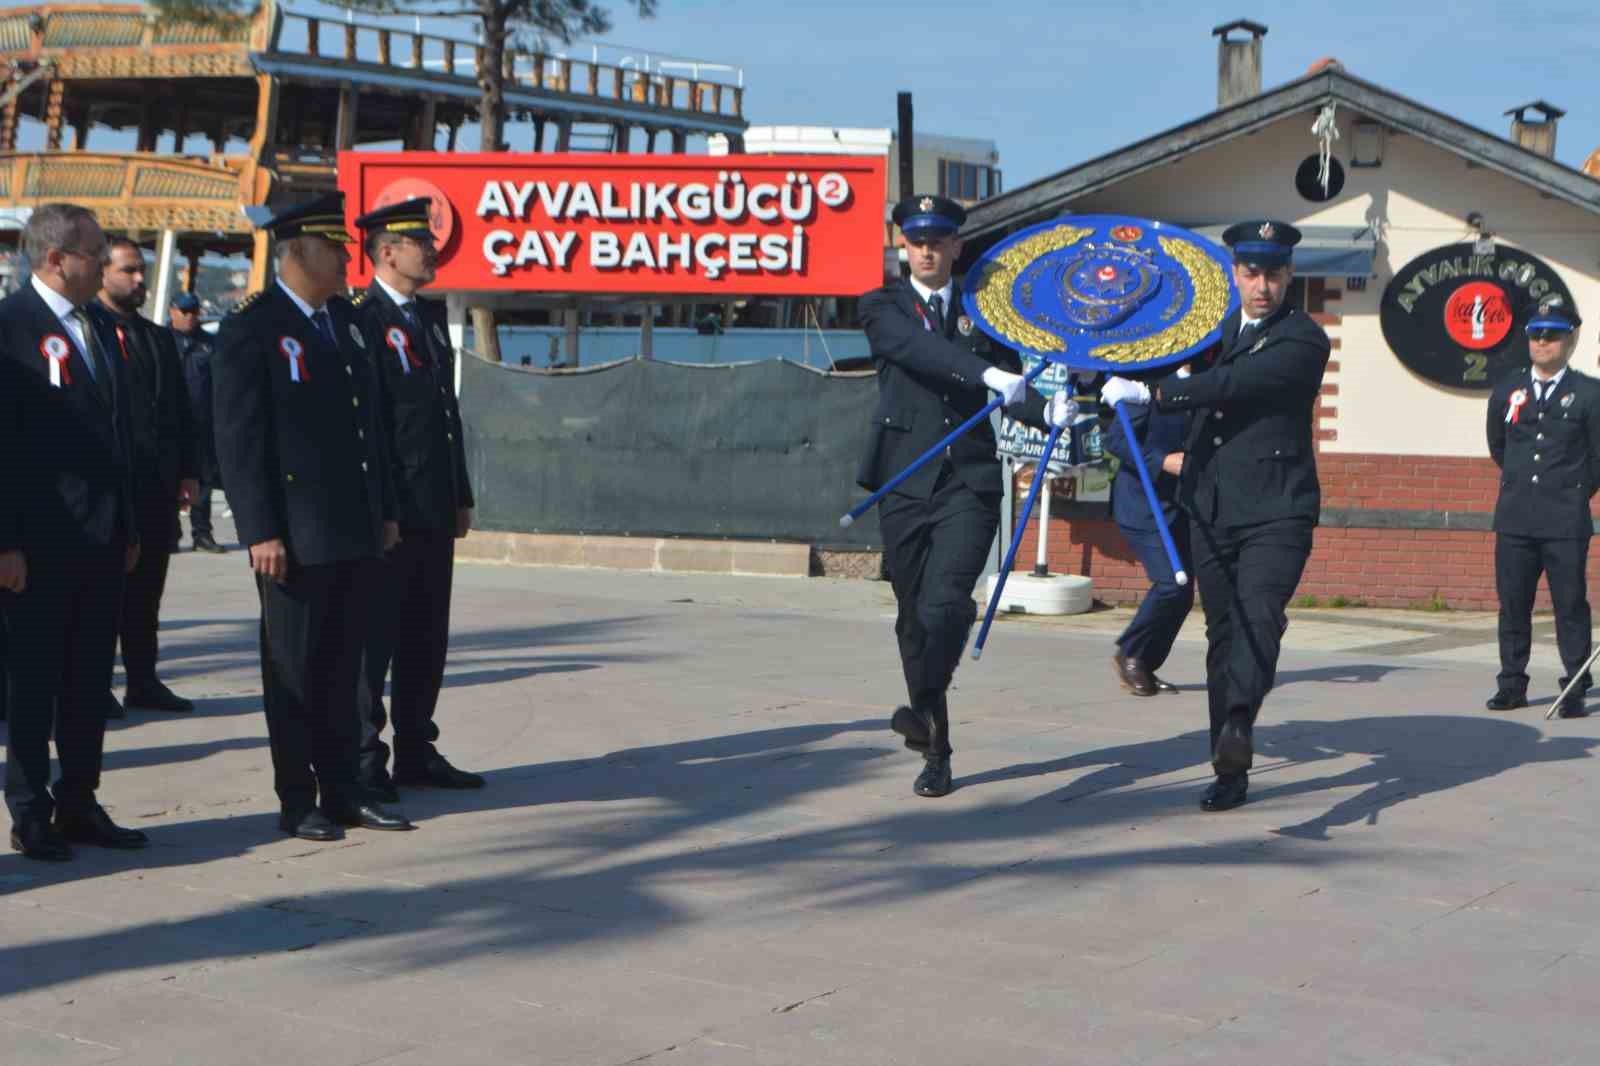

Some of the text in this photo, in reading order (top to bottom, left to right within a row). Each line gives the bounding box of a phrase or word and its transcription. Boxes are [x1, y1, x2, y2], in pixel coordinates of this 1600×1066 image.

[476, 172, 842, 219] AYVALIKGÜCÜ 2
[483, 226, 802, 277] ÇAY BAHÇESİ
[1398, 255, 1496, 314] AYVALIK
[1463, 353, 1488, 382] 2
